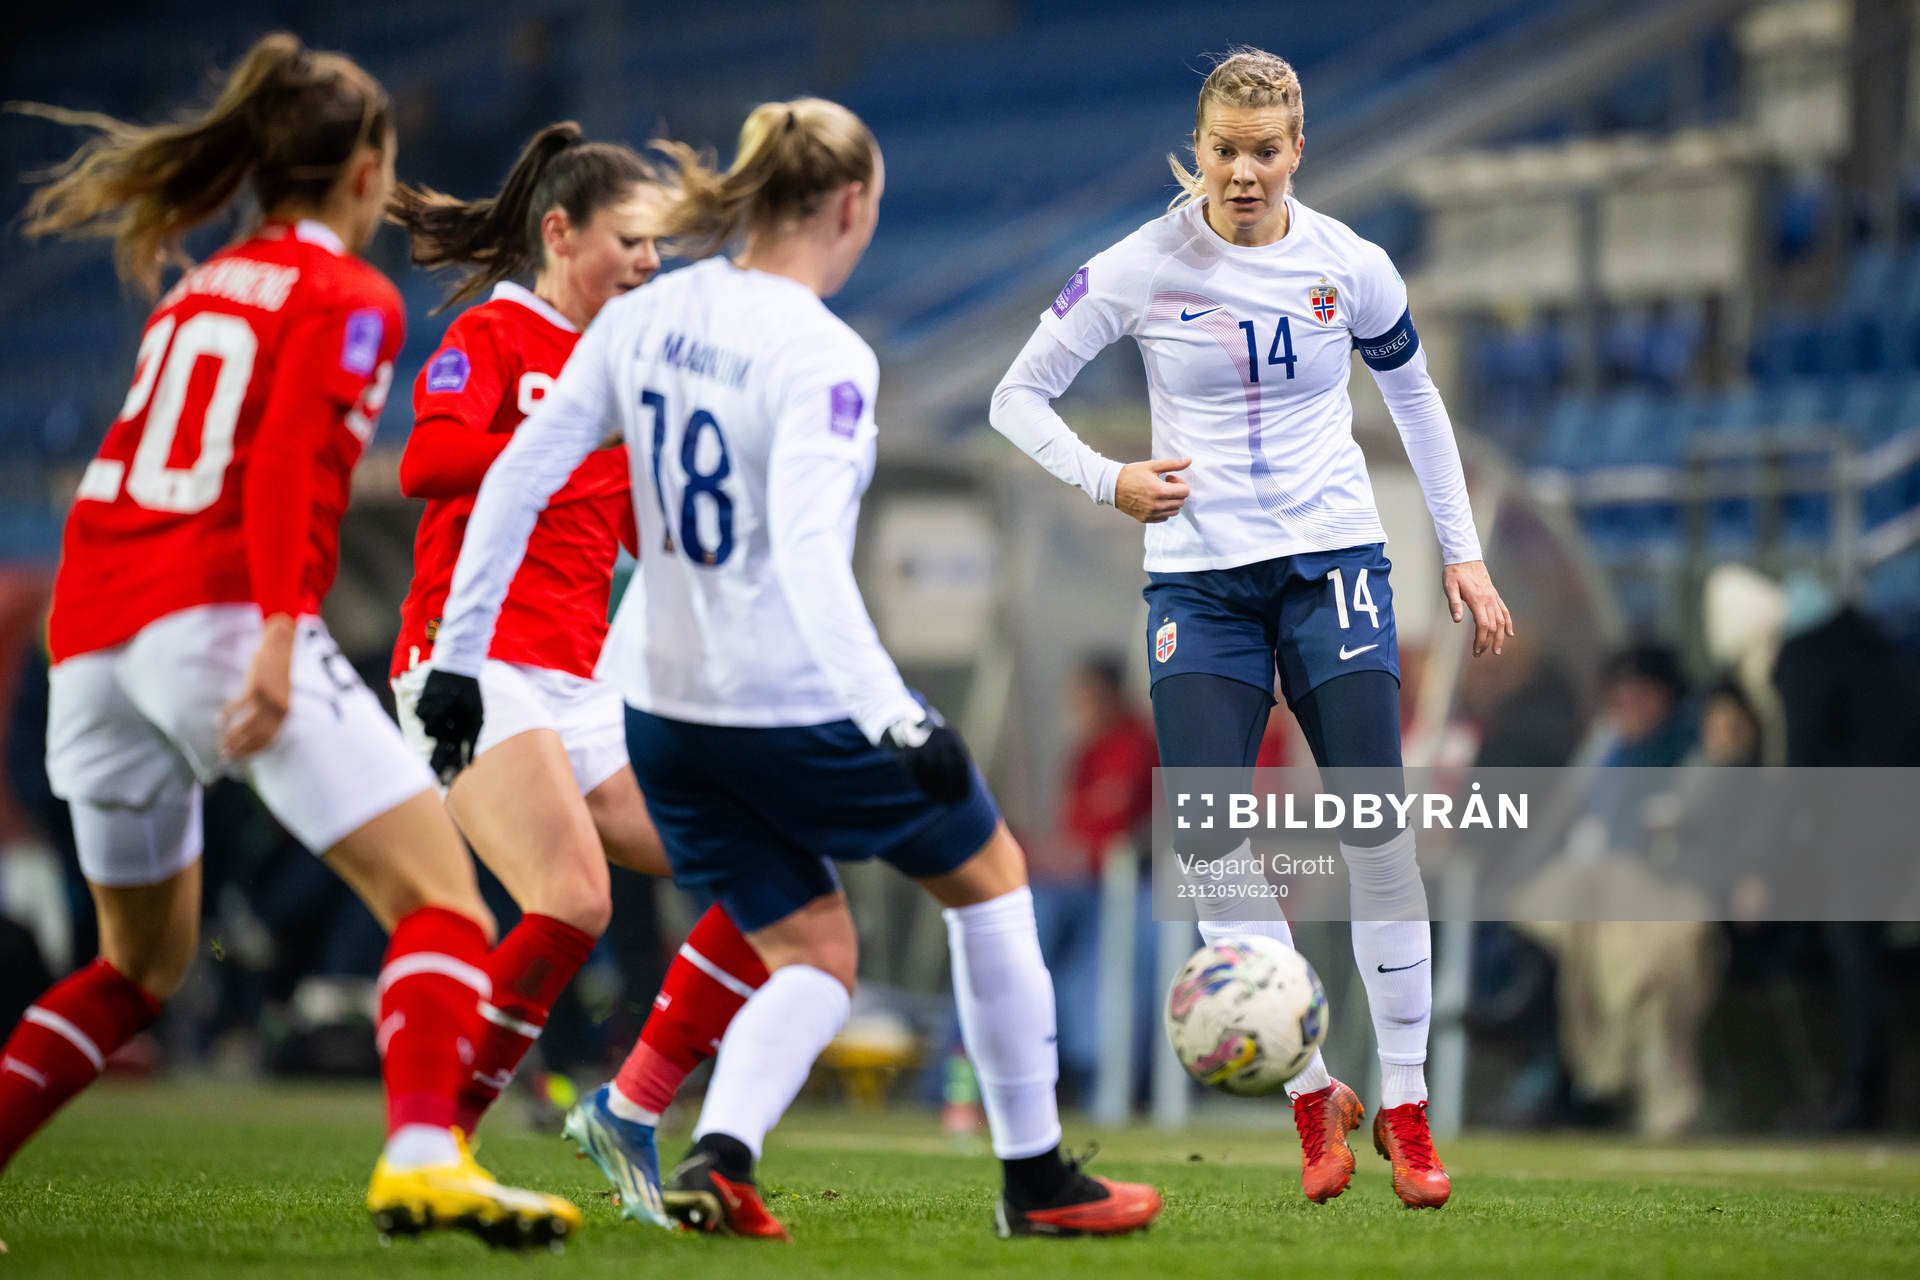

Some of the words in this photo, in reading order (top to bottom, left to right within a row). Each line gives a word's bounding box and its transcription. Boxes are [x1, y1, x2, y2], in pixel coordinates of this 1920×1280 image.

[1239, 316, 1298, 383] 14
[1364, 331, 1409, 357] RESPECT
[641, 388, 734, 568] 18
[1326, 567, 1380, 629] 14
